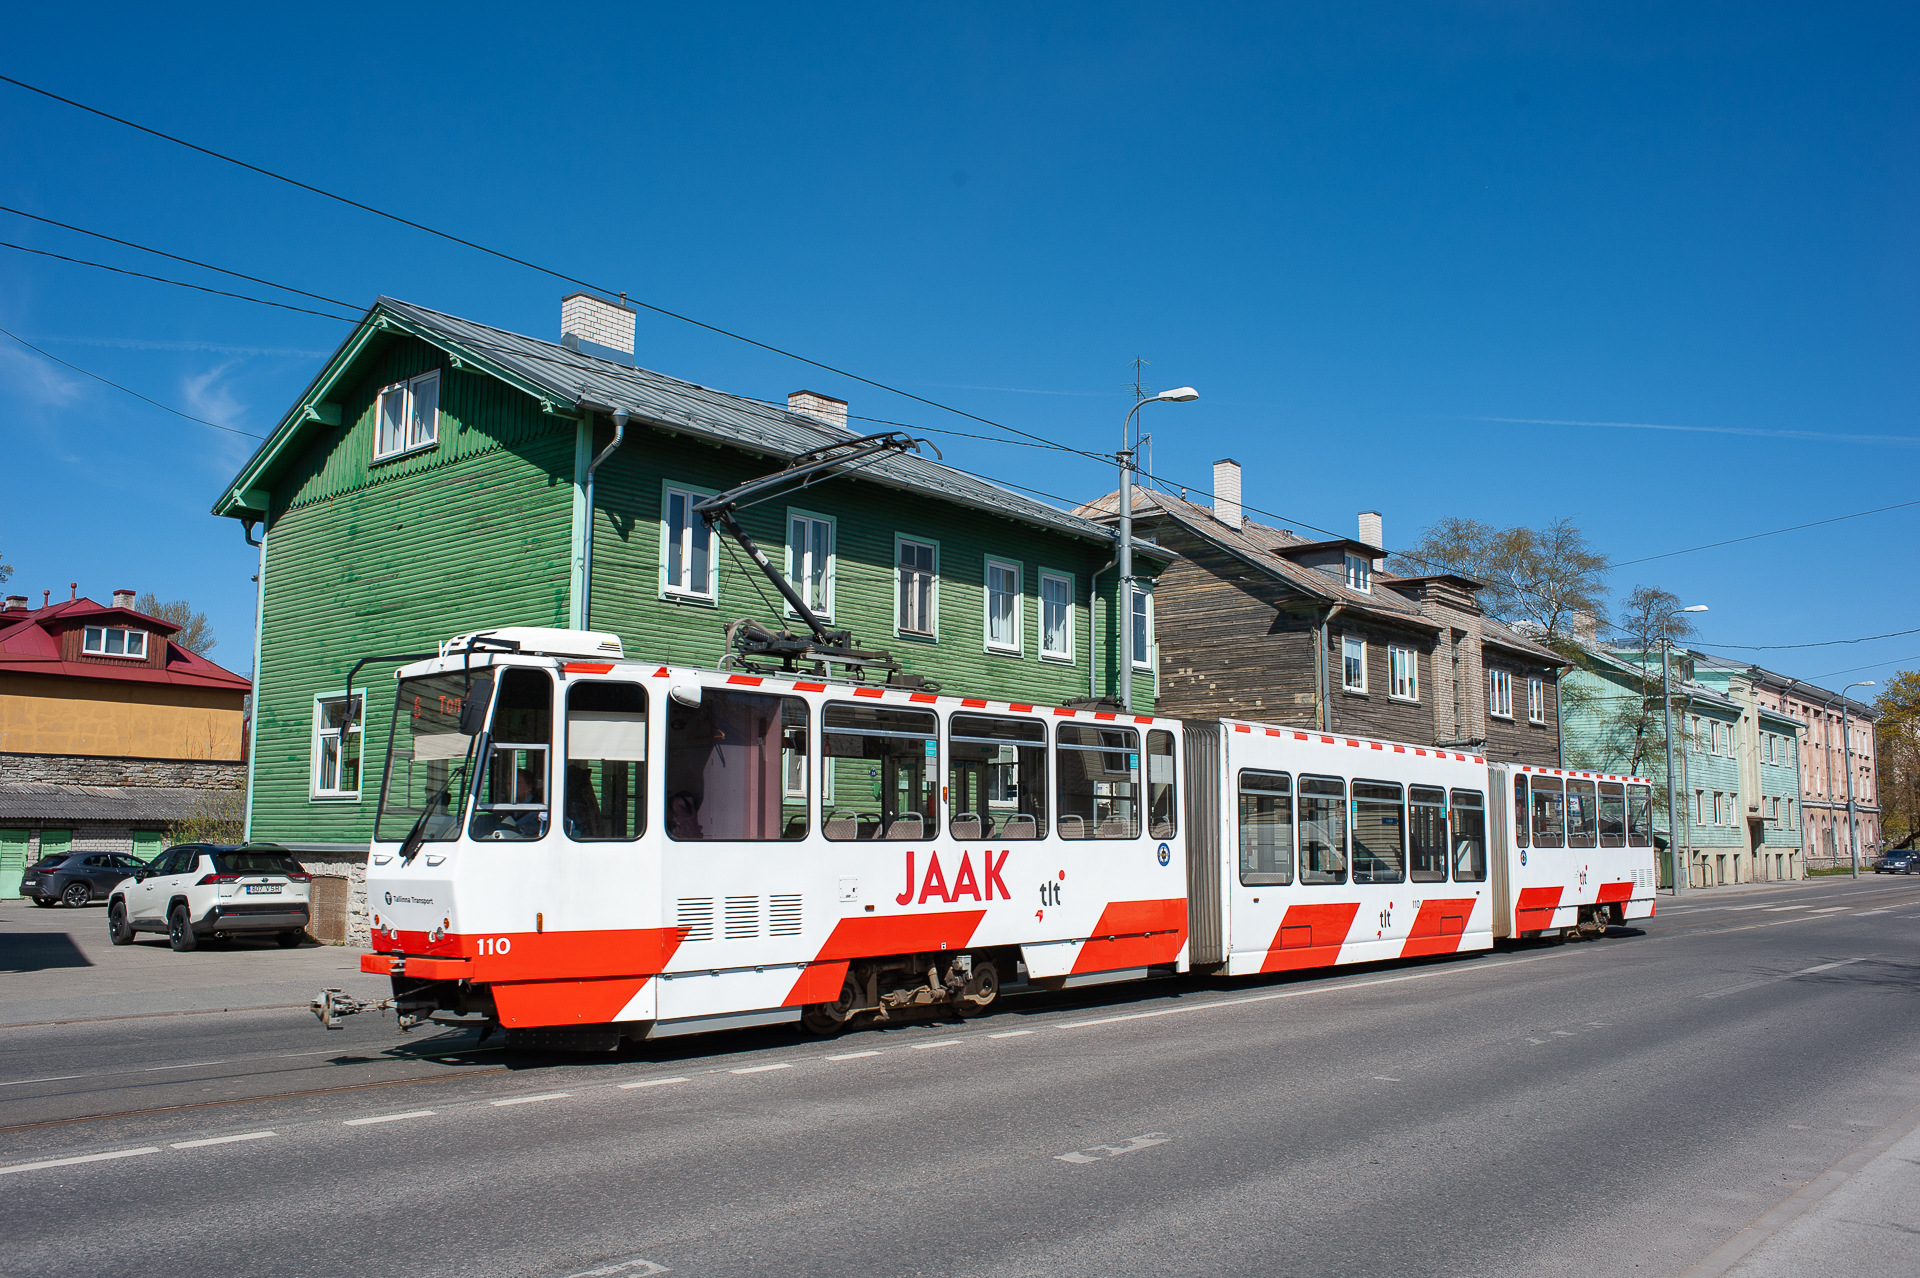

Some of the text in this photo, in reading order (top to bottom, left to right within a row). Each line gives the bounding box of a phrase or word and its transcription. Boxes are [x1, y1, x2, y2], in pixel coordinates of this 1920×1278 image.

[895, 849, 1012, 906] JAAK
[393, 895, 411, 904] Tallinna
[411, 896, 434, 906] Transport
[1039, 880, 1061, 907] tlt
[1412, 899, 1421, 909] 110
[1379, 908, 1391, 928] tlt
[476, 937, 511, 956] 110
